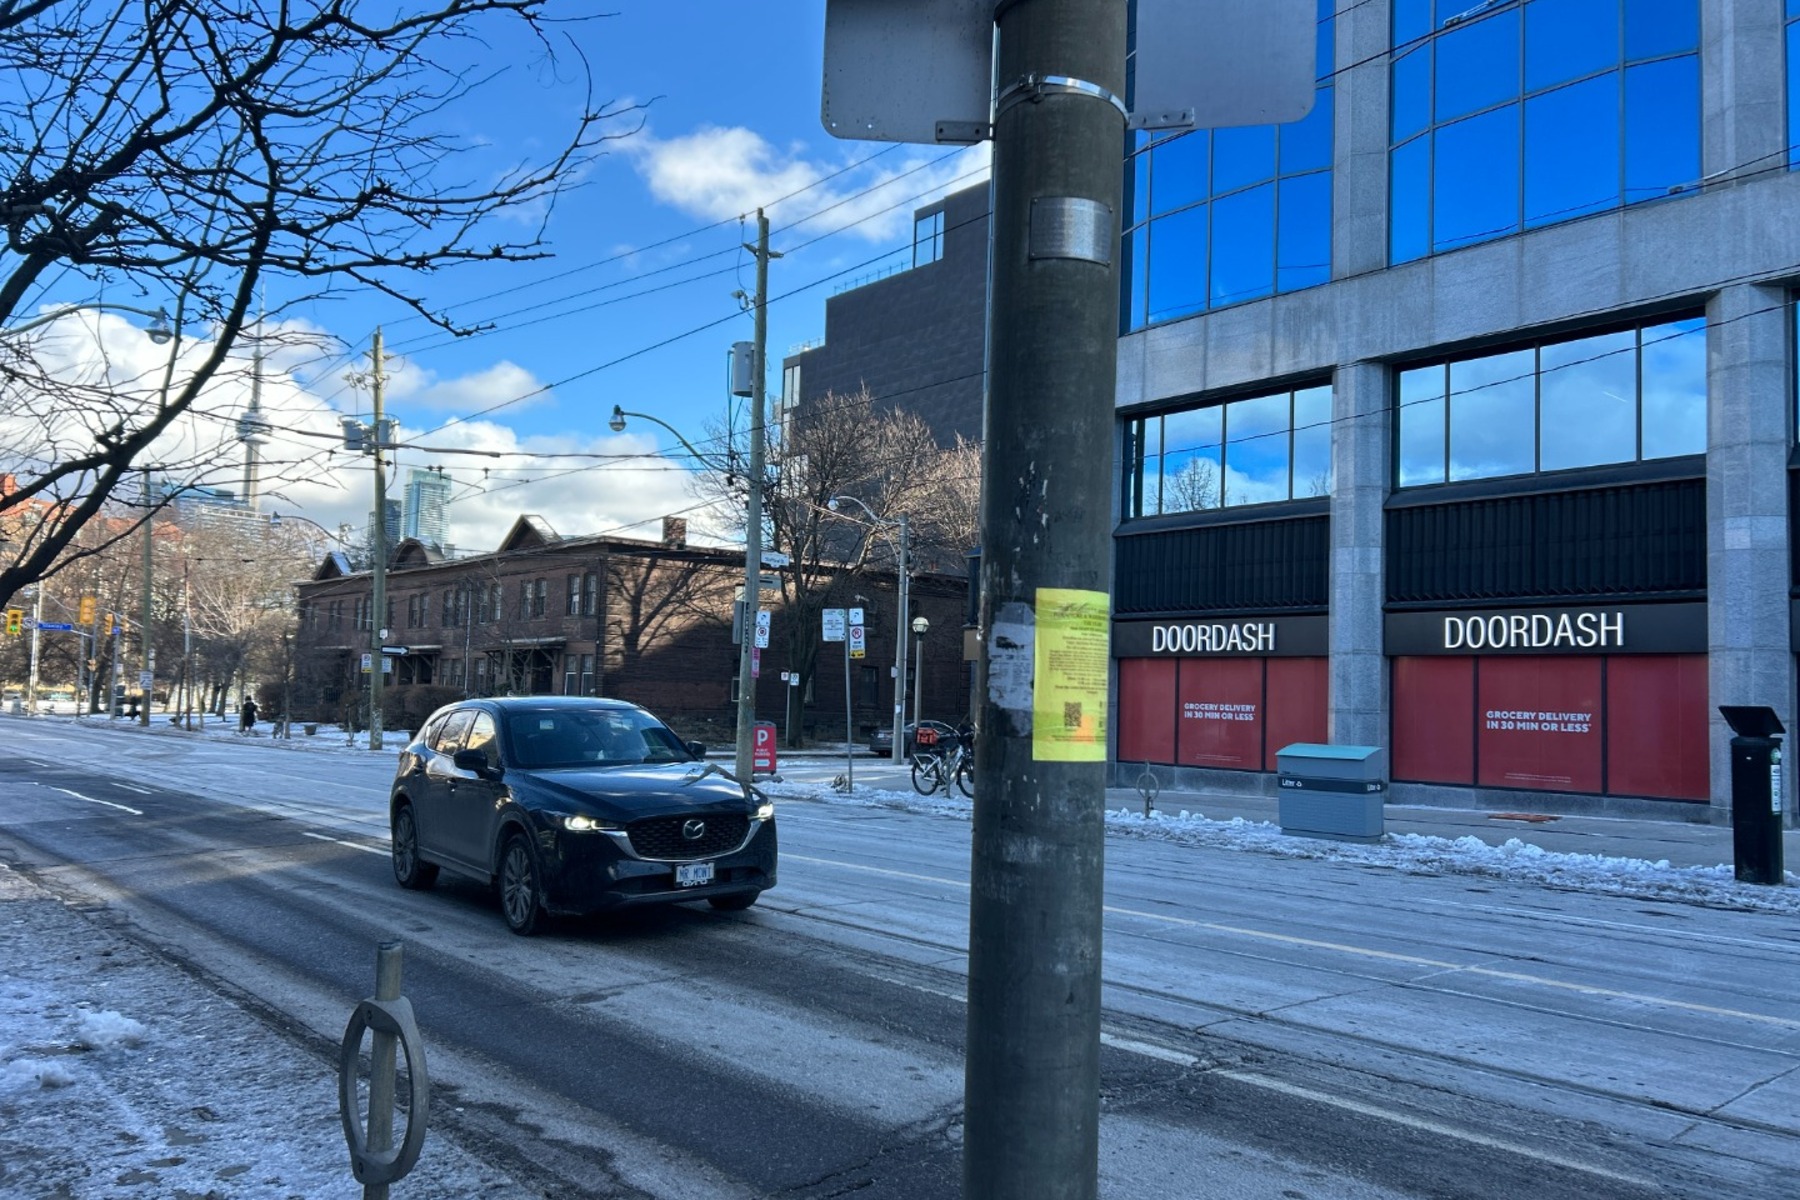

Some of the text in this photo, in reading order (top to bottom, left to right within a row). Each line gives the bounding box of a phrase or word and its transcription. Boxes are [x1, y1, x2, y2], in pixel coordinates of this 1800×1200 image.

[1444, 612, 1625, 648] DOORDASH
[1152, 623, 1275, 652] DOORDASH
[1184, 702, 1256, 712] GROCERY DELIVERY
[1194, 711, 1203, 719] 30
[1486, 710, 1592, 722] GROCERY DELIVERY
[1486, 720, 1499, 729] IN
[1501, 721, 1514, 730] 30
[1516, 721, 1539, 731] MIN
[1541, 723, 1558, 732] OR
[757, 729, 768, 746] P
